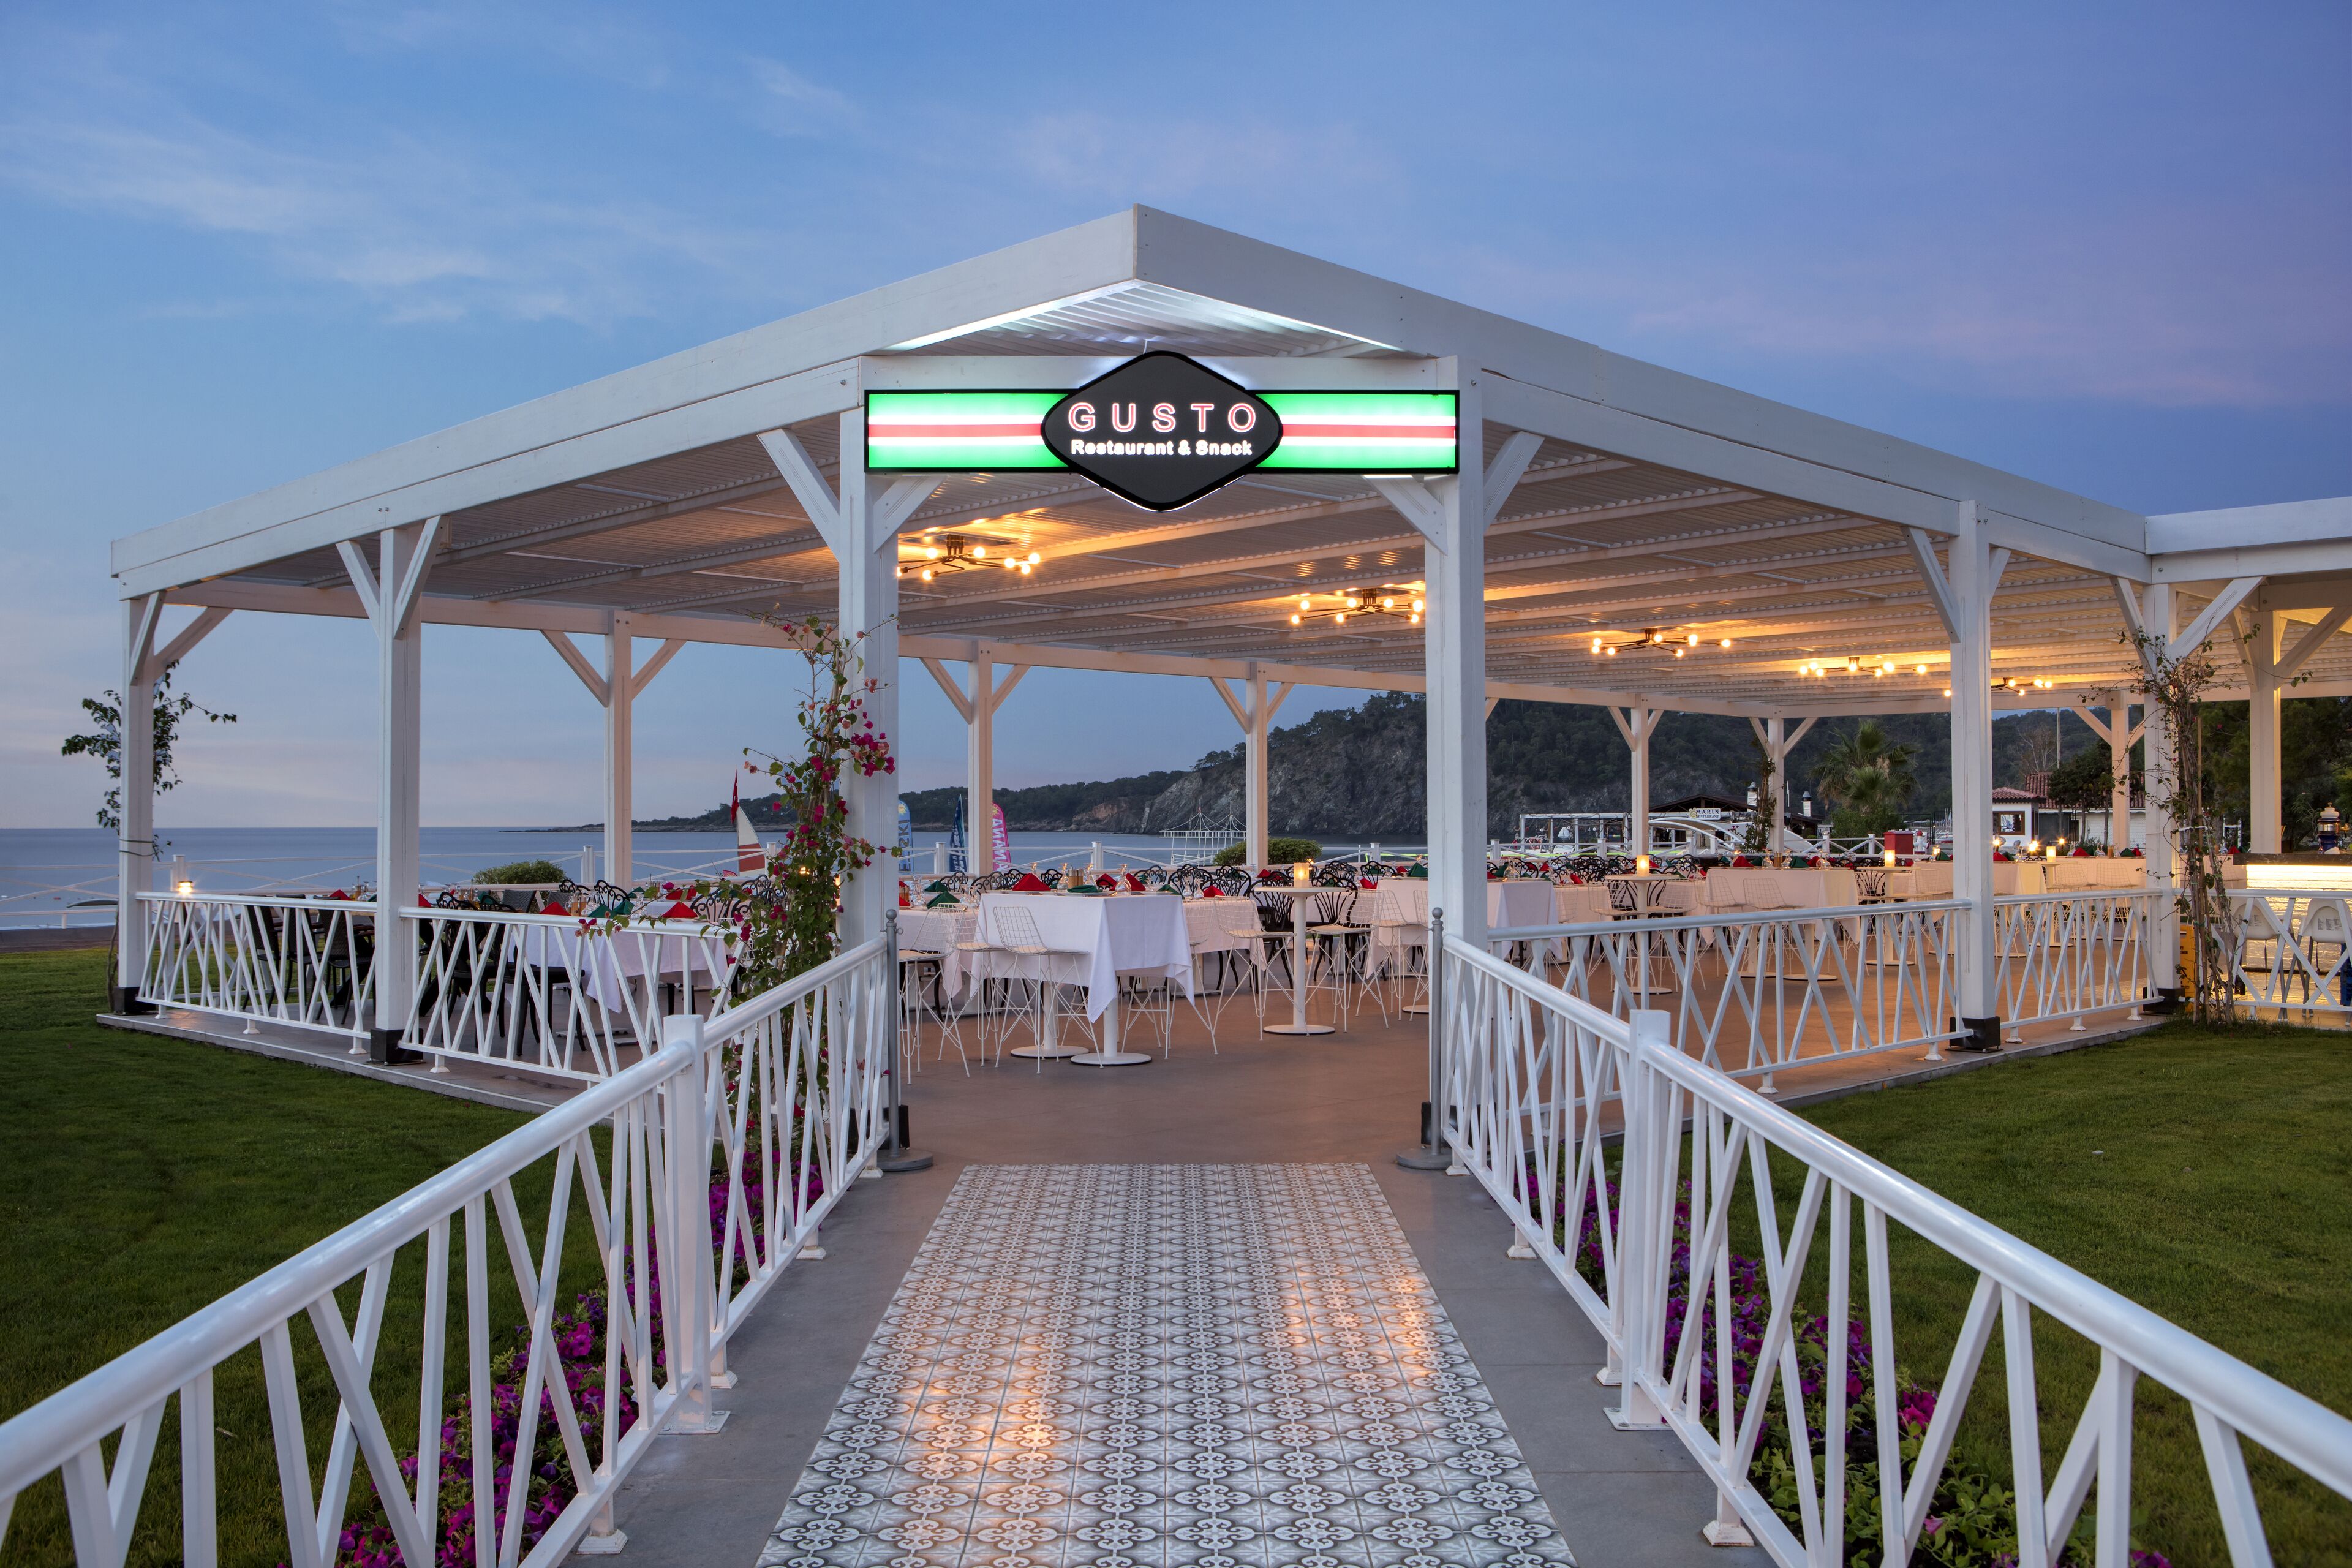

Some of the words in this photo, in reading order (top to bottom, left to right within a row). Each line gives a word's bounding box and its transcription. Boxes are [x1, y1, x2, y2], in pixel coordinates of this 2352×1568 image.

[1068, 402, 1256, 432] GUSTO
[1071, 439, 1174, 456] Restaurant
[1178, 440, 1191, 456] &
[1196, 440, 1253, 456] Snack
